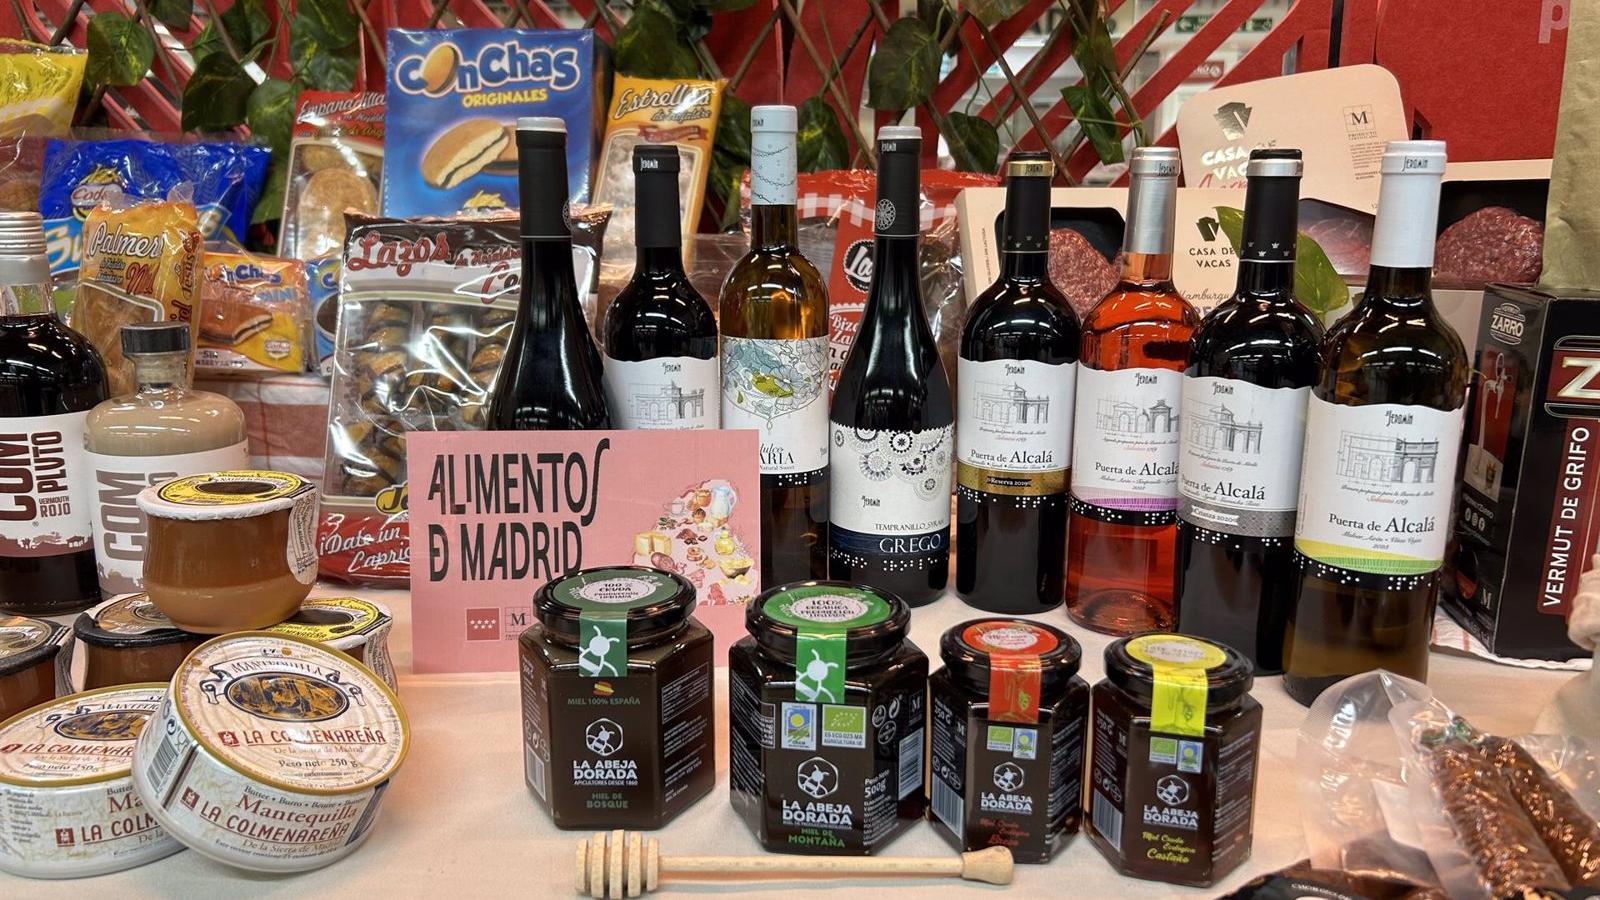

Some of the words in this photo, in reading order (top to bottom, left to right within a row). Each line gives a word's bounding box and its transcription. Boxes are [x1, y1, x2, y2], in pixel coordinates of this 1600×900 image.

[462, 88, 548, 108] ORIGINALES
[1351, 110, 1368, 126] M
[1213, 161, 1248, 181] VAC
[1189, 247, 1216, 256] CASA
[1221, 247, 1235, 255] DE
[1196, 259, 1231, 269] VACAS
[1491, 314, 1524, 337] ZARRO
[31, 431, 68, 493] PLUTO
[971, 449, 995, 462] Puerta
[997, 453, 1007, 462] de
[1010, 450, 1053, 464] Alcalá
[1564, 427, 1590, 490] GRIFO
[1095, 461, 1123, 474] Puerta
[1125, 466, 1137, 476] de
[1201, 482, 1212, 493] de
[1214, 480, 1266, 500] Alcalá
[40, 503, 71, 518] ROJO
[96, 469, 148, 561] COM
[1560, 497, 1579, 520] DE
[1329, 512, 1364, 530] Puerta
[1367, 520, 1381, 532] de
[1384, 516, 1435, 533] Alcalá
[460, 521, 583, 582] MADRID
[879, 533, 941, 554] GREGO
[1543, 525, 1573, 606] VERMUT
[511, 613, 526, 626] M
[588, 697, 608, 705] 100%
[609, 696, 640, 706] ESPAÑA
[243, 730, 264, 744] LA
[270, 726, 387, 744] COMENAREÑA
[21, 743, 44, 753] LA
[47, 743, 134, 757] COLMENAR
[279, 758, 302, 769] Peso
[330, 757, 347, 767] 250
[350, 759, 358, 769] g
[573, 760, 590, 769] LA
[595, 760, 637, 769] ABEJA
[573, 769, 638, 780] DORADA
[106, 784, 134, 796] Butter
[981, 791, 995, 800] LA
[1000, 793, 1034, 804] ABEJA
[109, 792, 144, 815] Ma
[235, 793, 358, 828] Mantequilla
[587, 800, 629, 809] BOSQUE
[782, 799, 801, 811] LA
[805, 802, 853, 815] ABEJA
[980, 799, 1033, 812] DORADA
[1143, 804, 1159, 815] LA
[1163, 807, 1199, 819] ABEJA
[200, 801, 222, 823] LA
[226, 814, 350, 843] COLMENAREÑA
[782, 810, 853, 826] DORADA
[1143, 812, 1199, 828] DORADA
[81, 825, 103, 842] LA
[111, 812, 159, 838] COLM
[801, 828, 820, 836] MIEL
[788, 834, 846, 848] MONTAÑA
[1146, 848, 1190, 864] Castaño
